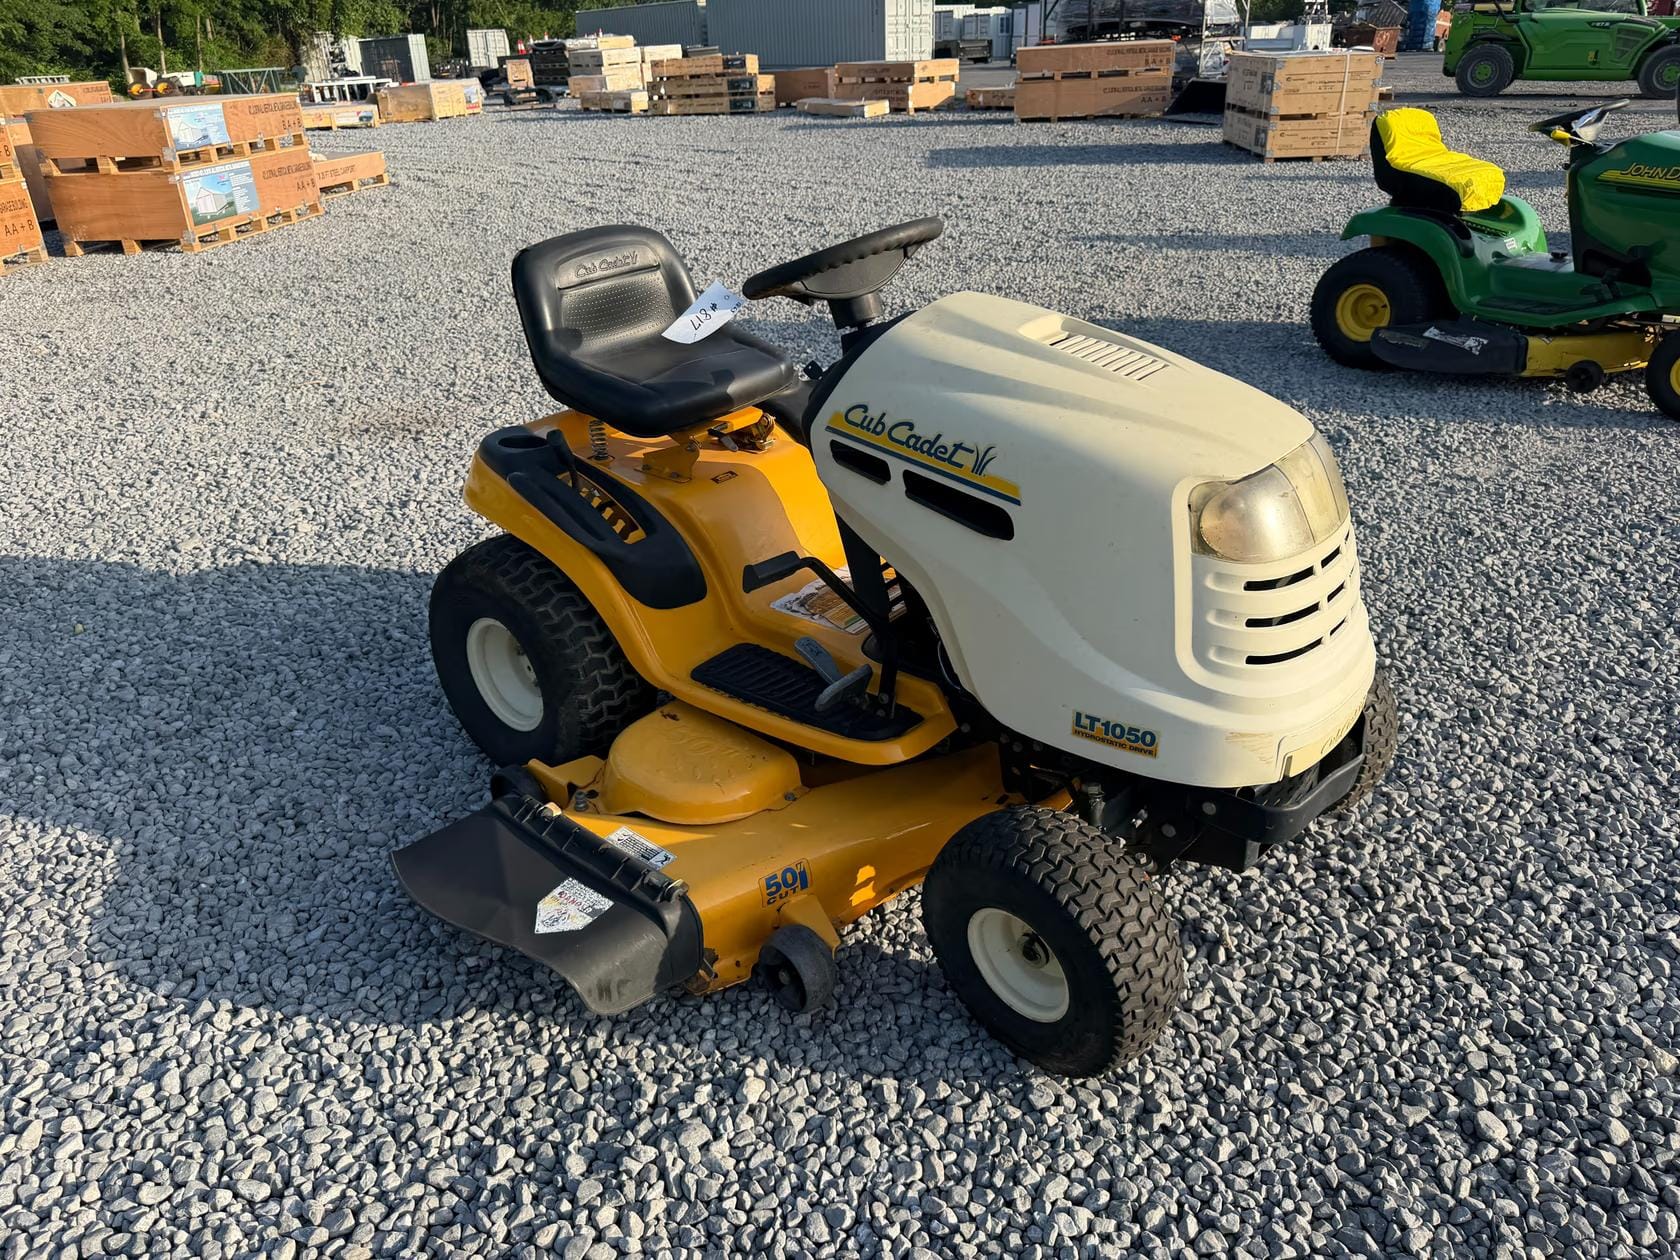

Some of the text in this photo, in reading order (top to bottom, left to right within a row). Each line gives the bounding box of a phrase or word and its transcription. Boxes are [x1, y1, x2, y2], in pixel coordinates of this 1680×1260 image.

[1620, 162, 1667, 178] JOHN
[4, 223, 20, 237] AA
[27, 219, 35, 231] B
[844, 404, 974, 469] Cub Cadet
[1074, 729, 1154, 755] HYDROSTATIC DRIVE
[1075, 711, 1156, 747] LT1050
